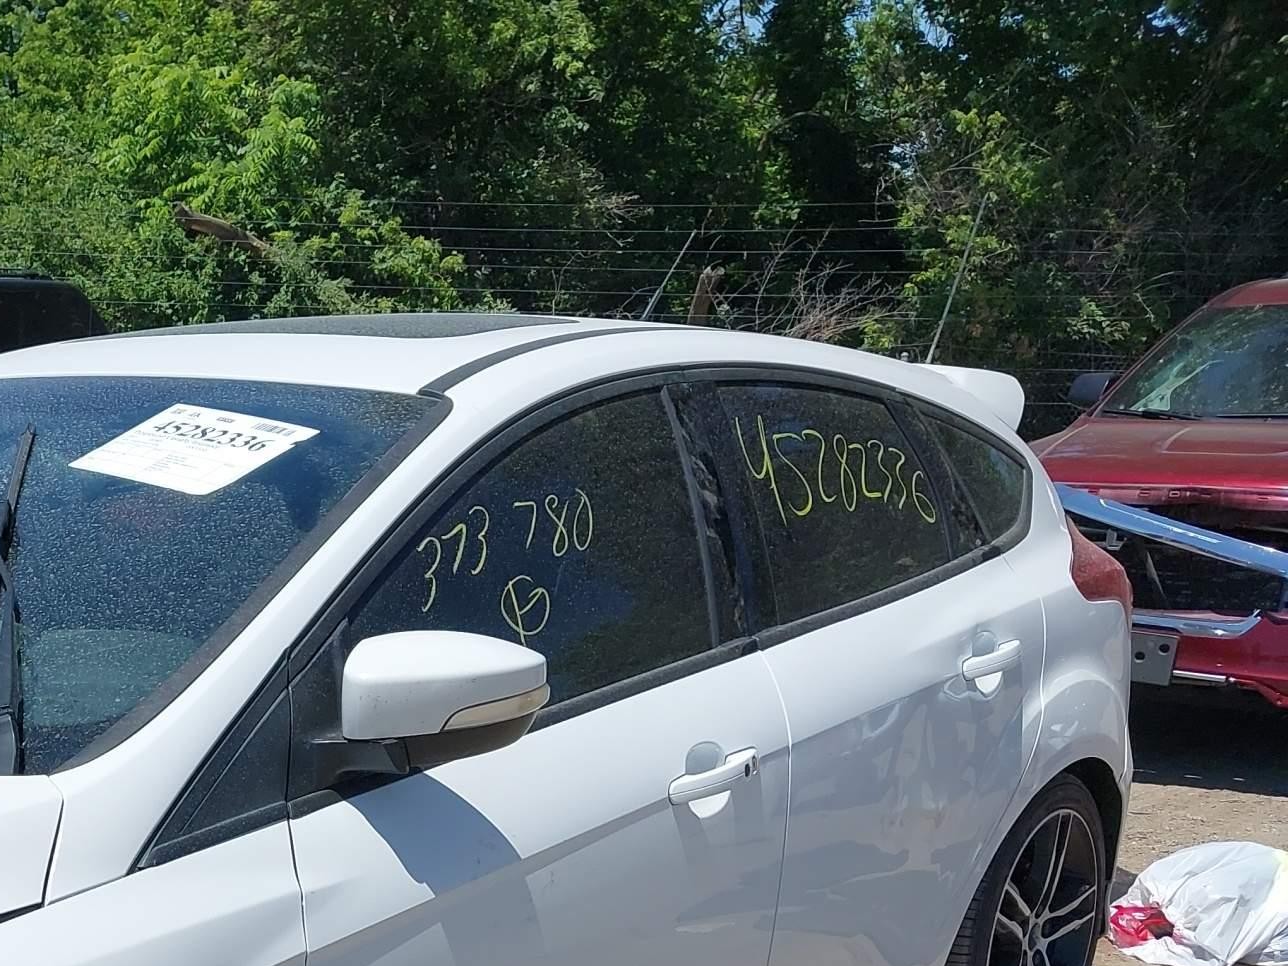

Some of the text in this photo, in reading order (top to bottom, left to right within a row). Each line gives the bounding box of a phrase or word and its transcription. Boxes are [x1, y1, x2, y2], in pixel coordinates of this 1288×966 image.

[154, 420, 275, 452] 45282336
[735, 415, 936, 527] 45282336
[416, 488, 594, 613] 373 780
